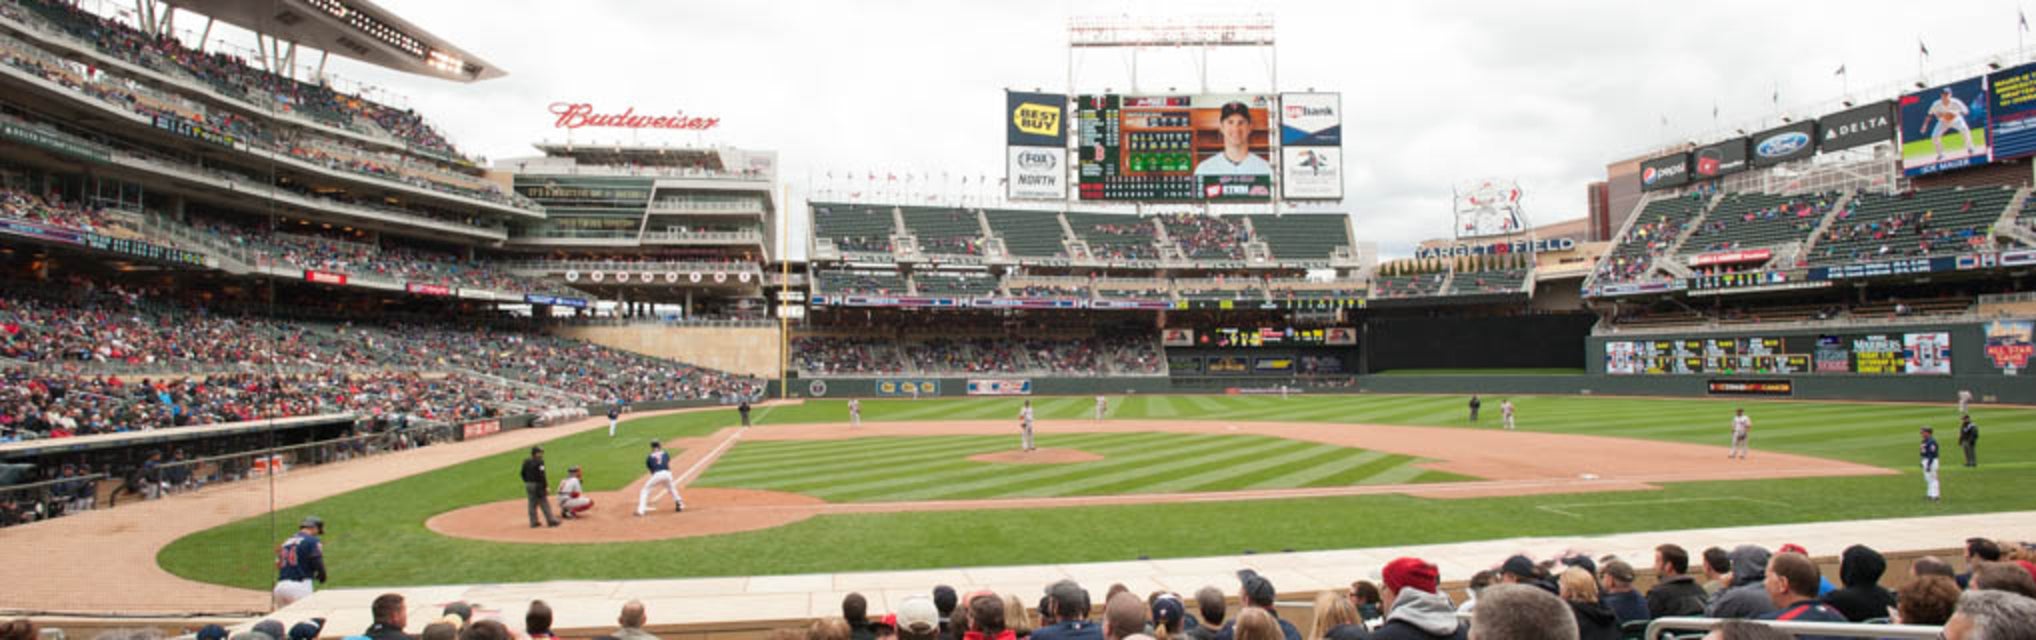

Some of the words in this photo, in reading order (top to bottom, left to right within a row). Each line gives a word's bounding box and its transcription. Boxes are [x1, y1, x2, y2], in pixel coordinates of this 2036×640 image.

[548, 101, 720, 130] Budweiser
[1020, 108, 1057, 121] BEST
[1021, 118, 1053, 131] BUY
[1839, 115, 1888, 137] DELTA
[1025, 153, 1047, 163] FOX
[1657, 162, 1686, 180] pepsi
[1018, 174, 1056, 187] NORTH
[1415, 242, 1490, 259] TARGET
[1511, 238, 1575, 253] FIELD
